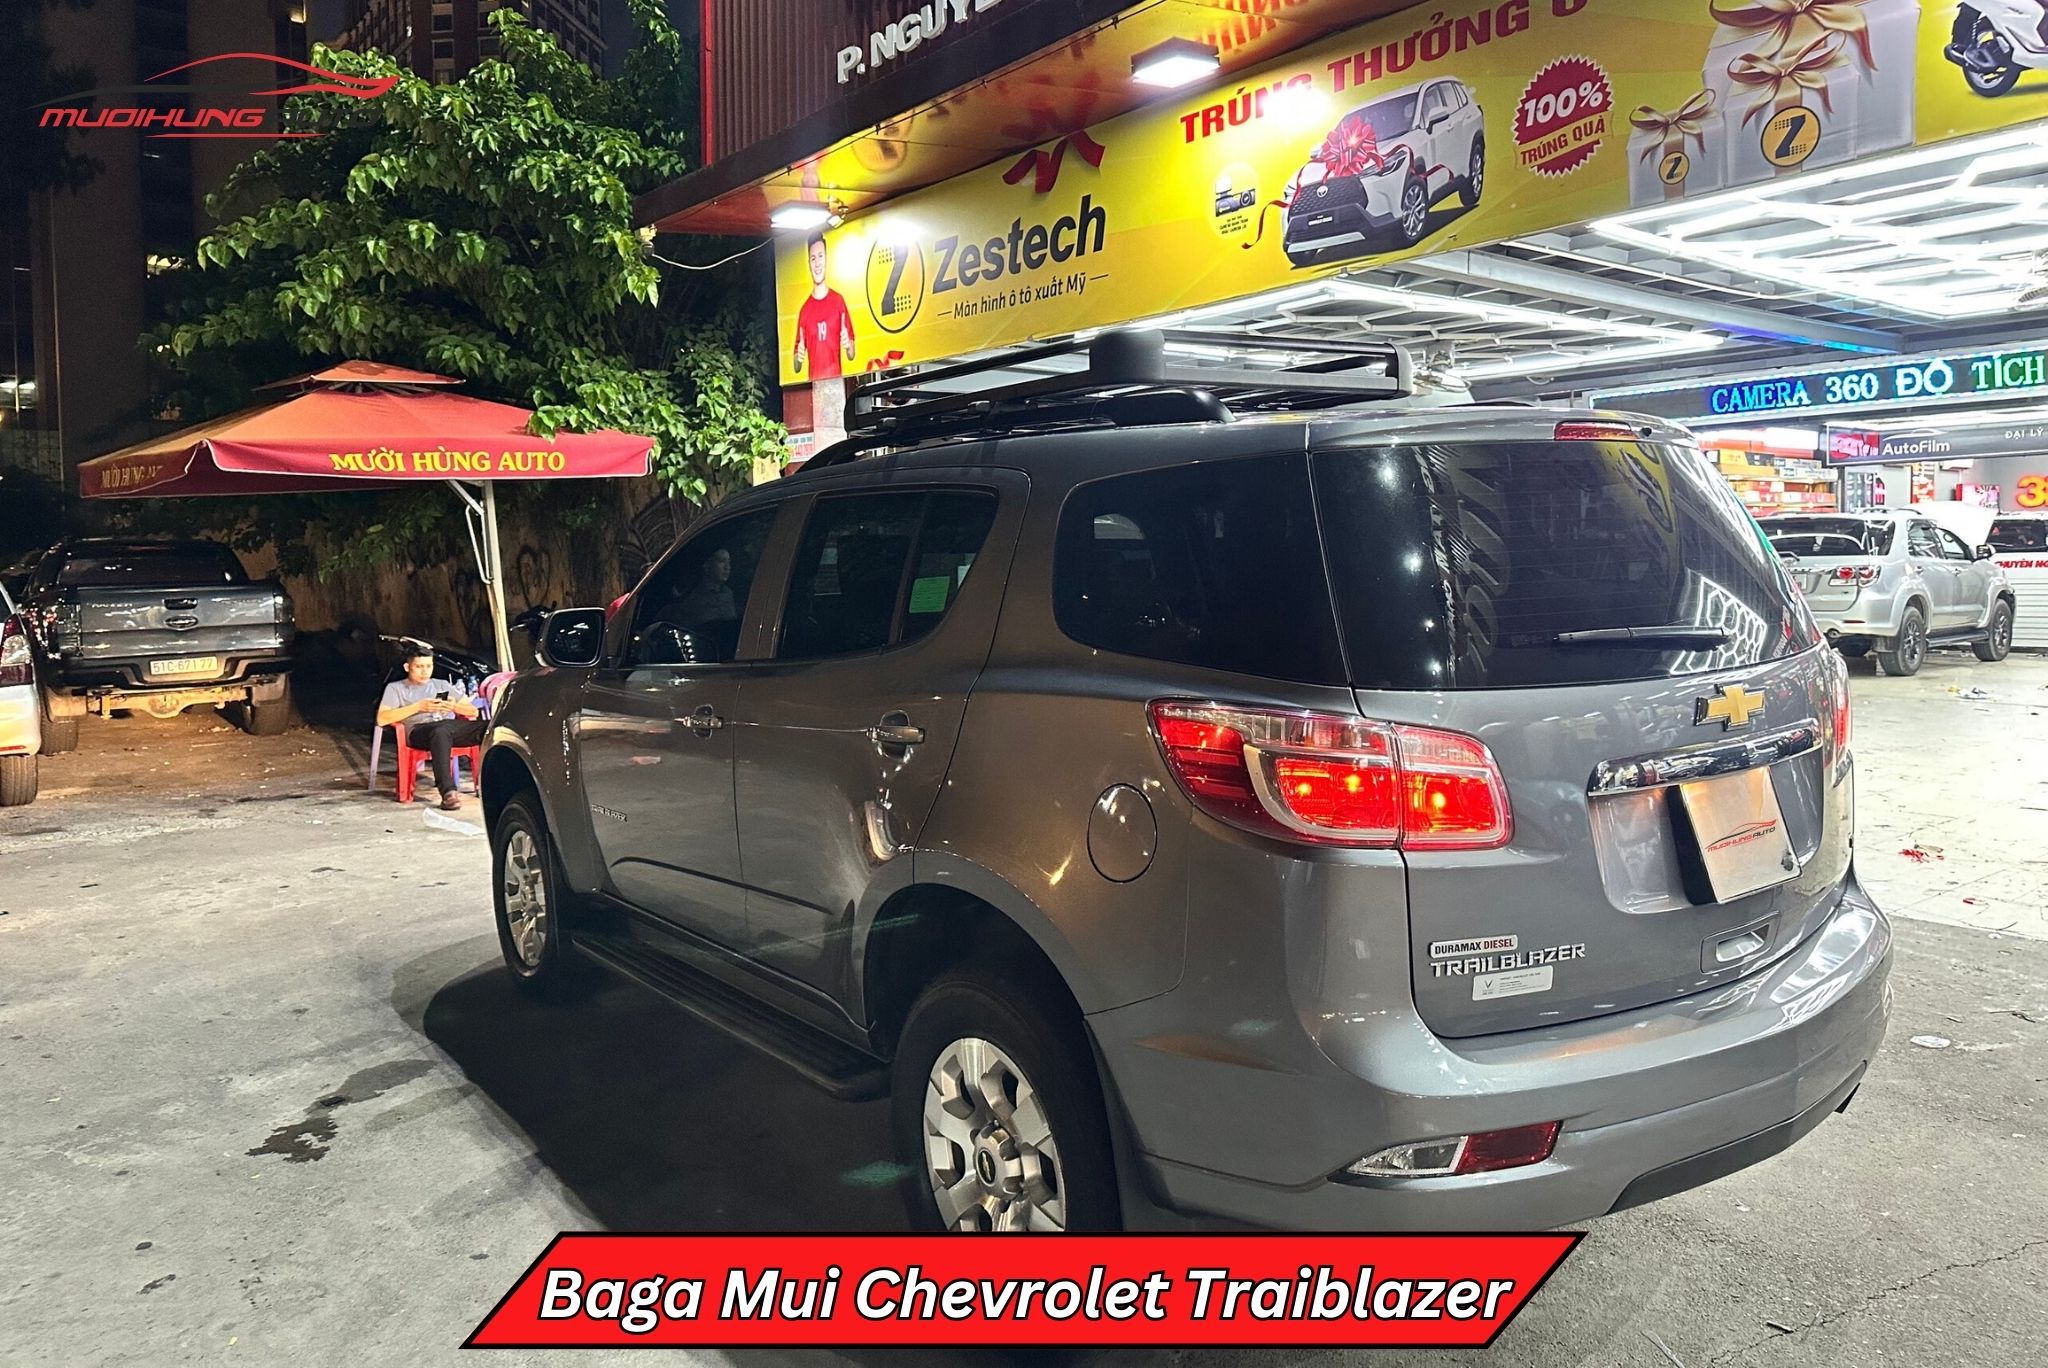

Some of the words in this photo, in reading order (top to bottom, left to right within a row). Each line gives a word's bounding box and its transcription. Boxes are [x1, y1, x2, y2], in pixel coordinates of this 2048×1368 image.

[870, 0, 1005, 68] NGUY
[1327, 0, 1529, 93] THƯỞNG
[1524, 81, 1603, 127] 100%
[1520, 140, 1568, 165] TRÚNG
[932, 194, 1106, 294] Zestech
[953, 301, 978, 320] Màn
[980, 294, 1006, 314] hình
[1009, 289, 1016, 307] ô
[1019, 285, 1032, 304] tô
[1035, 277, 1063, 302] xuất
[1066, 272, 1087, 295] Mỹ
[1712, 380, 1811, 413] CAMERA
[1826, 372, 1879, 403] 360
[1971, 353, 2046, 390] TÍCH
[329, 447, 404, 472] MƯỜI
[412, 446, 491, 472] HÙNG
[498, 451, 566, 472] AUTO
[1882, 440, 1951, 456] AutoFilm
[2016, 475, 2048, 508] 3
[1430, 943, 1586, 978] TRAILBLAZER
[1434, 941, 1482, 955] DURAMAX
[1483, 938, 1514, 950] DIESEL
